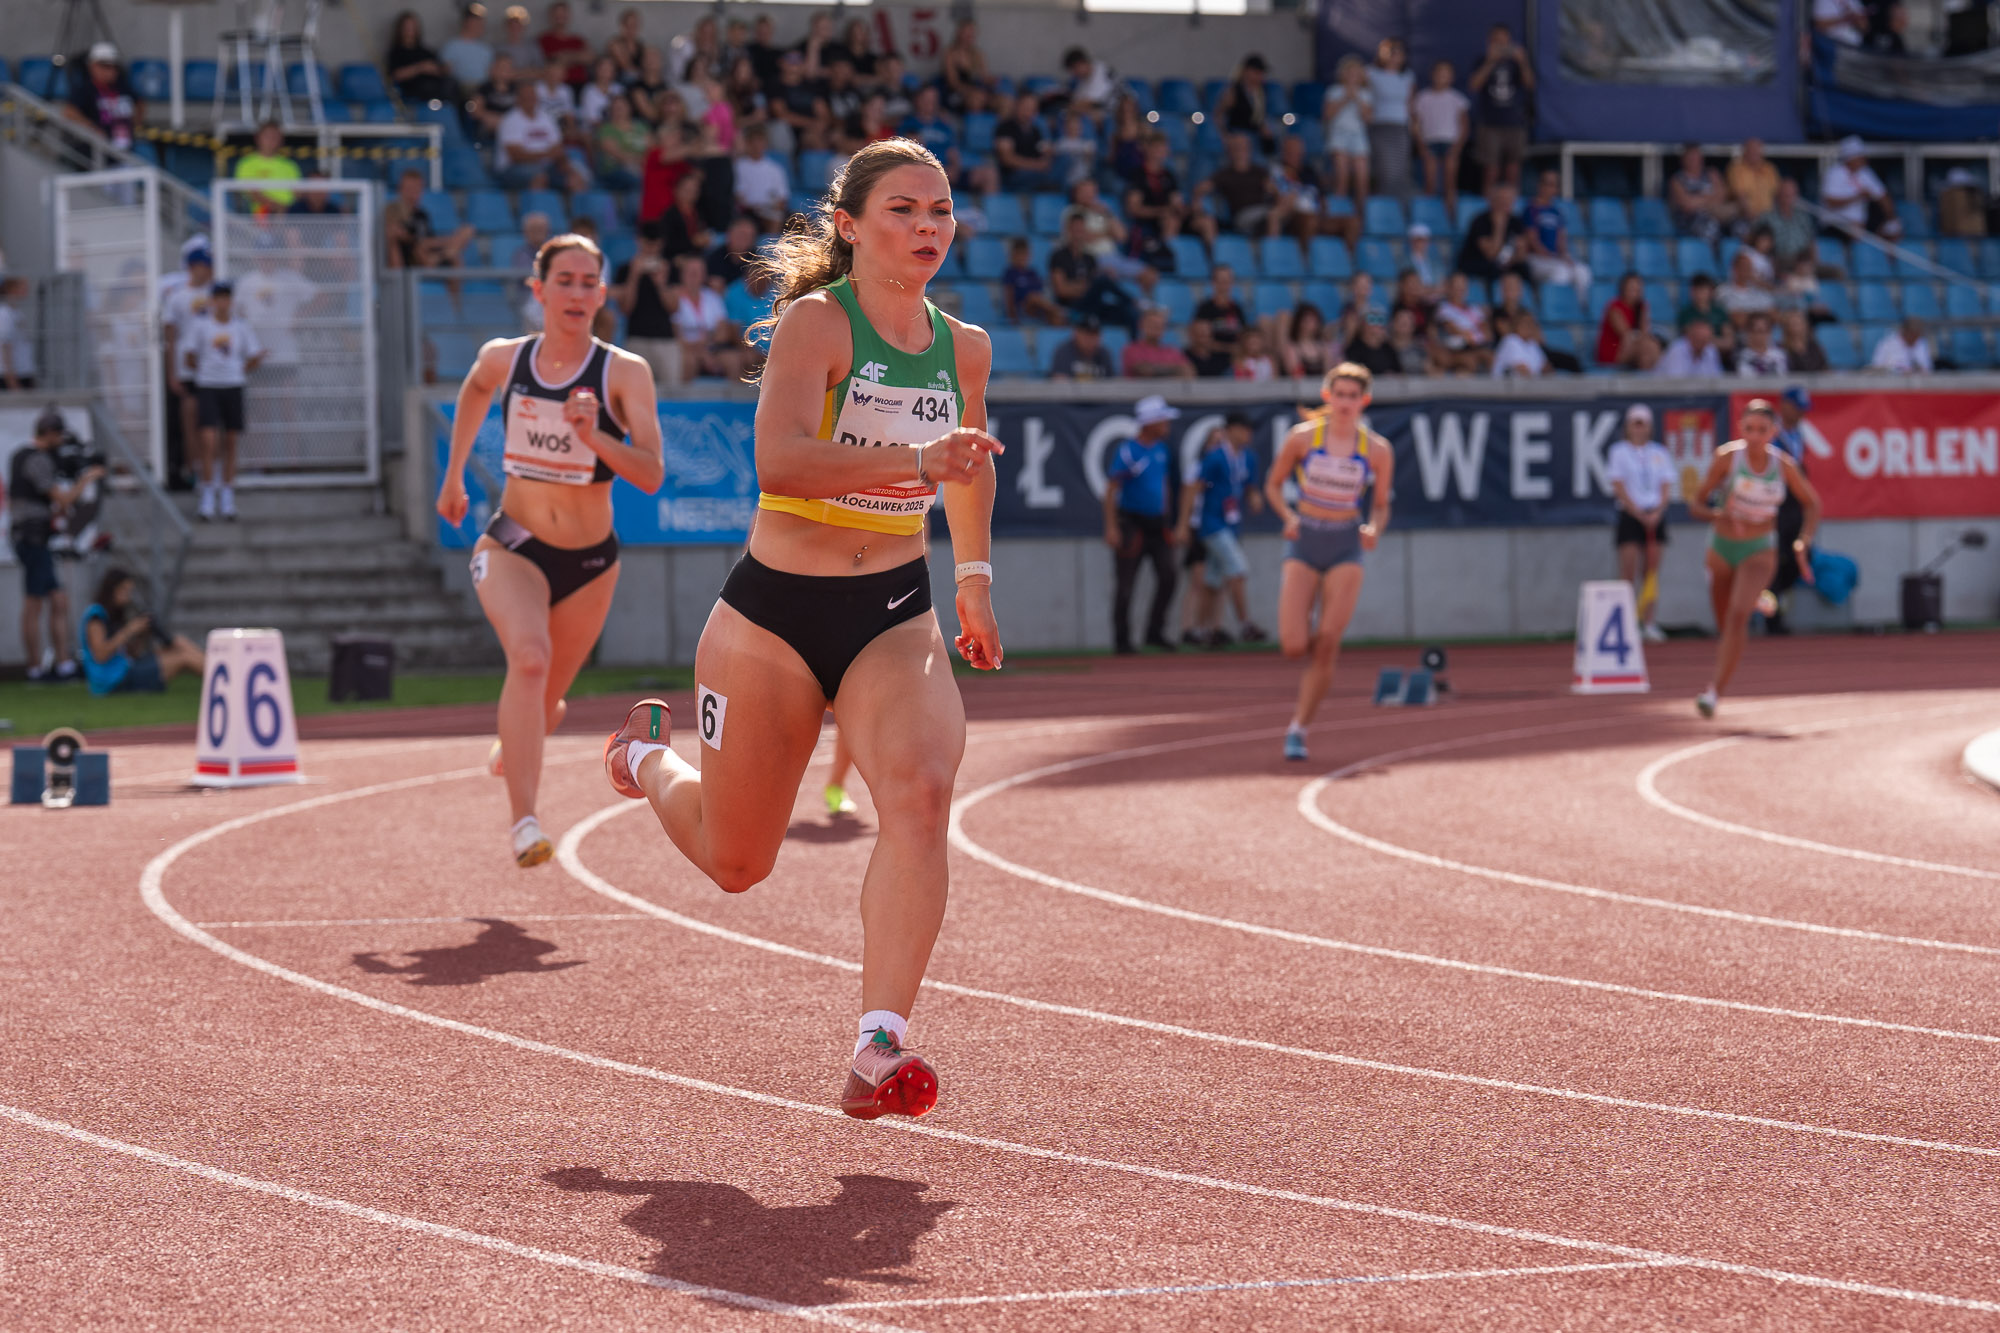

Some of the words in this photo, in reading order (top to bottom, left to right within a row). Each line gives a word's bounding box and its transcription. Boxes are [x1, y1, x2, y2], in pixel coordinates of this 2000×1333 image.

[859, 361, 888, 383] 4F
[912, 396, 949, 423] 434
[527, 430, 572, 454] WOŚ
[1844, 427, 1998, 478] ORLEN
[904, 501, 924, 511] 2025
[1597, 603, 1633, 666] 4
[208, 663, 230, 748] 6
[246, 661, 282, 748] 6
[702, 694, 717, 740] 6
